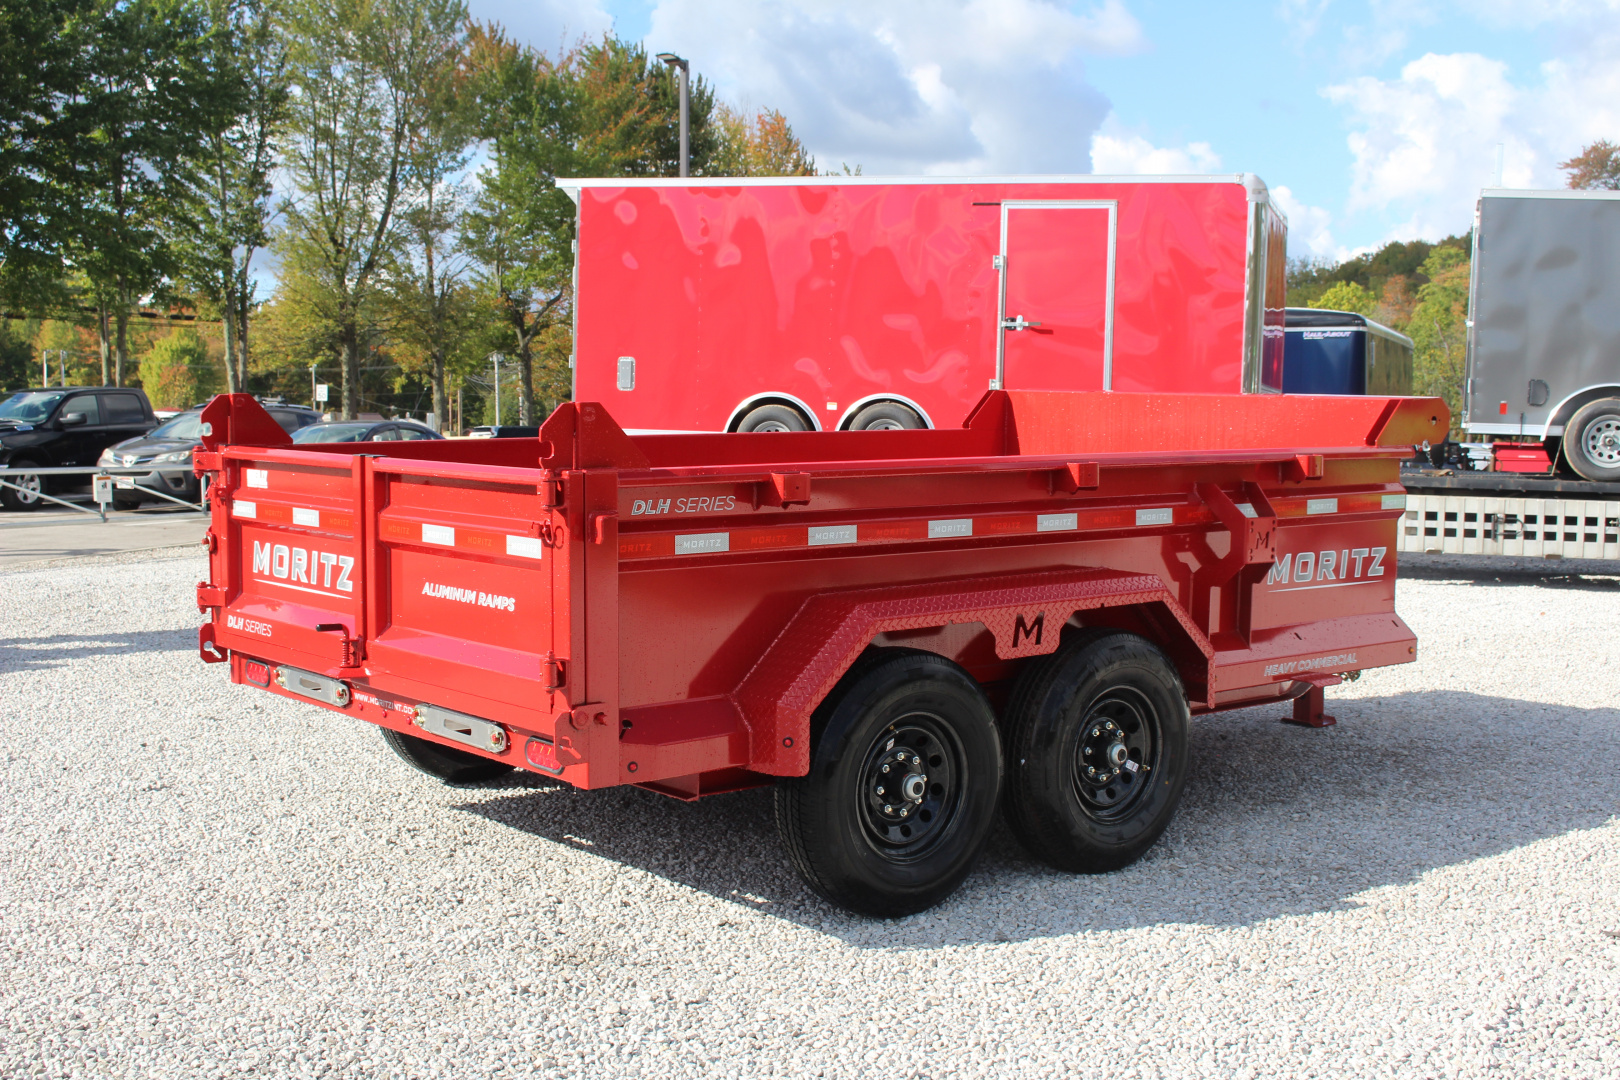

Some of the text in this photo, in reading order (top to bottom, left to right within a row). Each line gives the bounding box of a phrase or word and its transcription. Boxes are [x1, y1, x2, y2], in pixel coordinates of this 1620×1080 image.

[631, 496, 736, 515] DLH SERIES
[388, 525, 410, 535] MORITZ
[467, 536, 492, 547] MORITZ
[620, 543, 652, 553] ORITZ
[683, 539, 721, 548] MORITZ
[751, 534, 788, 544] MORITZ
[815, 531, 849, 540] MORITZ
[876, 527, 909, 536] MORITZ
[934, 524, 966, 533] MORITZ
[990, 521, 1021, 530] MORITZ
[1042, 518, 1072, 527] MORITZ
[1093, 515, 1121, 524] MORITZ
[1141, 513, 1167, 521] MORITZ
[1256, 531, 1270, 549] M
[253, 540, 354, 592] MORITZ
[1267, 547, 1387, 585] MORITZ
[422, 582, 516, 612] ALUMINUM RAMPS
[227, 615, 272, 637] DLH SERIES
[1012, 611, 1045, 648] M
[1264, 653, 1358, 676] HEAVY COMMERCIAL
[354, 692, 413, 714] WWW.MORITZINT.CO
